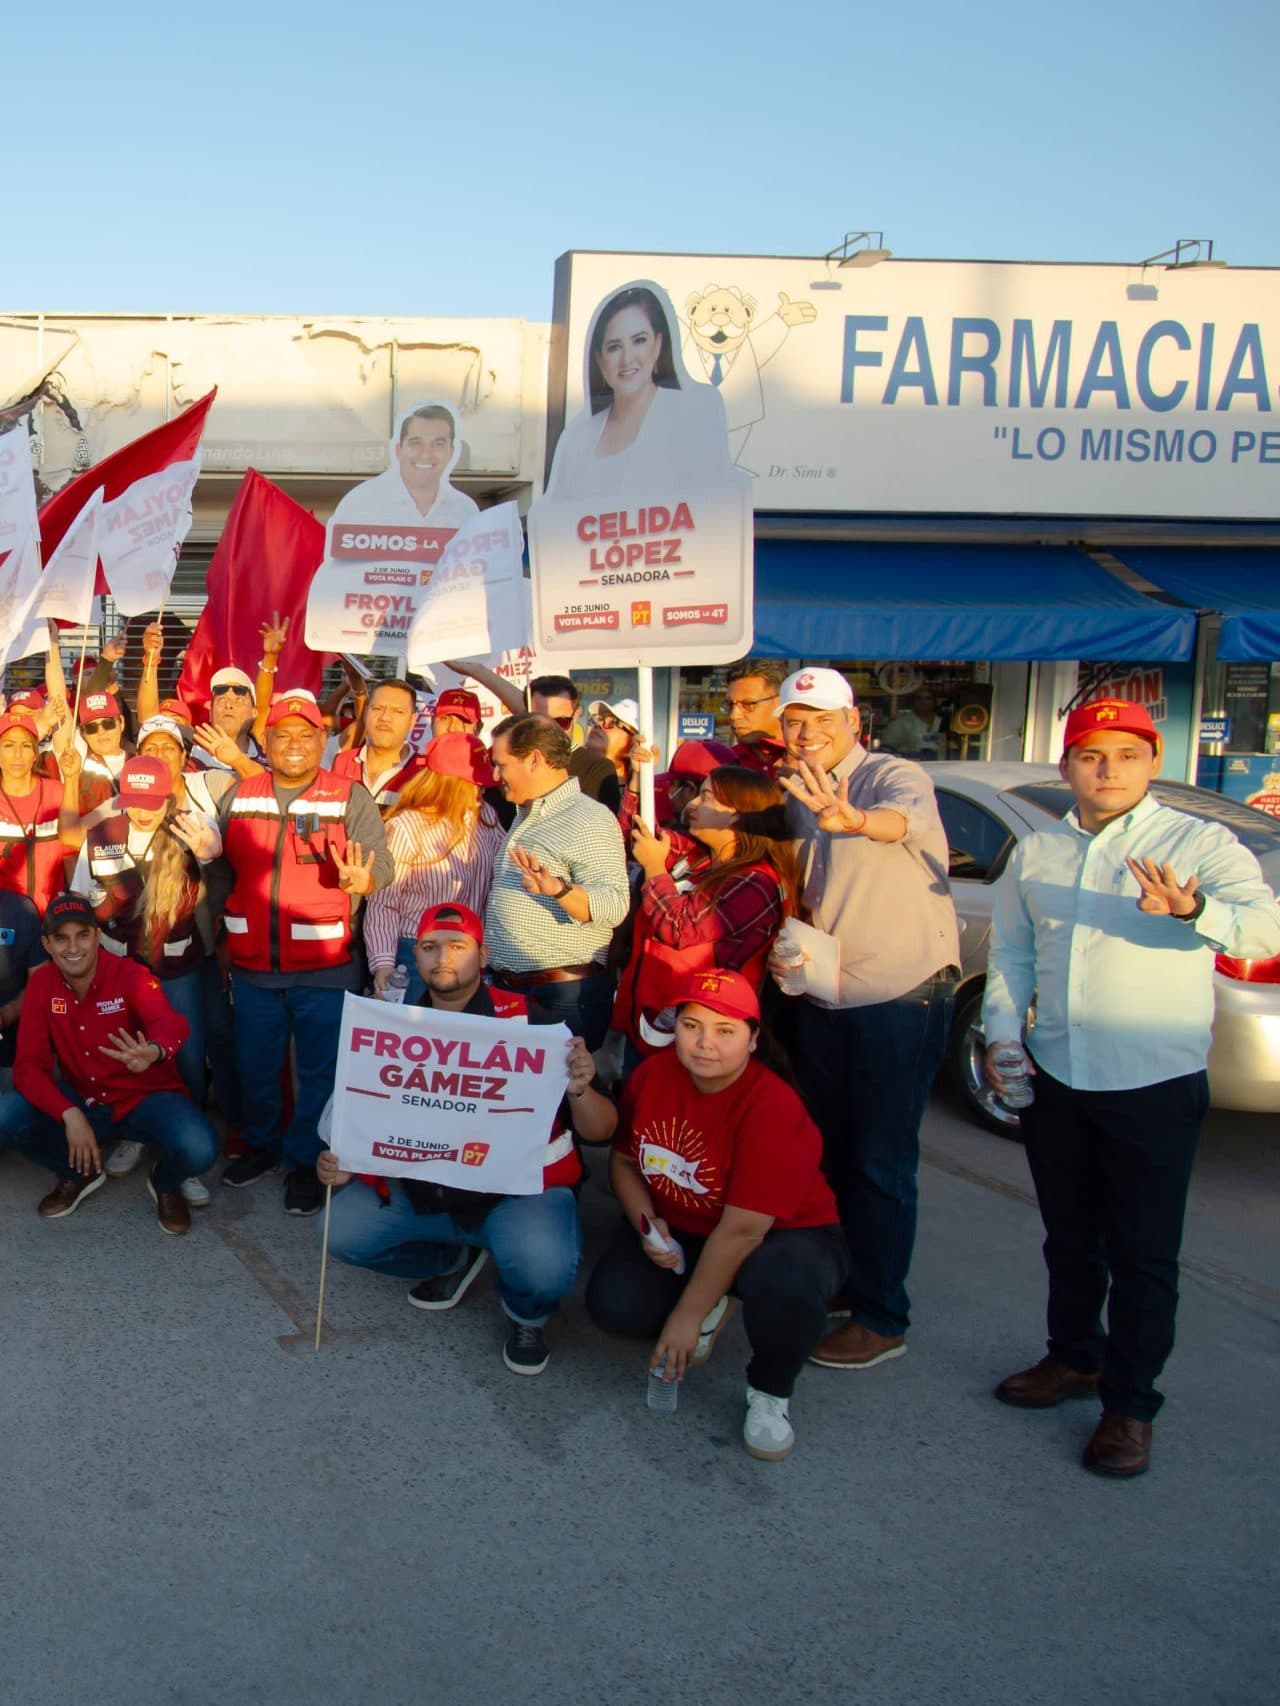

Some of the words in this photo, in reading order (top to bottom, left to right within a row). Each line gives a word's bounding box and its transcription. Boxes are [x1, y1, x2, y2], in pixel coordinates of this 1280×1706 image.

[840, 315, 1280, 413] FARMACIA
[1080, 429, 1217, 463] MISMO
[577, 502, 695, 541] CELIDA
[341, 533, 417, 551] SOMOS
[424, 540, 439, 549] LA
[590, 539, 682, 571] LÓPEZ
[601, 570, 670, 586] SENADORA
[345, 593, 417, 612] FROYL
[584, 603, 610, 611] JUNIO
[559, 618, 581, 627] VOTA
[583, 616, 606, 625] PLAN
[608, 616, 615, 624] C
[632, 610, 649, 623] PT
[666, 612, 700, 621] SOMOS
[711, 609, 724, 619] 4T
[682, 718, 709, 728] DESLICE
[350, 1027, 546, 1075] FROYLÁN
[379, 1063, 508, 1101] GÁMEZ
[401, 1094, 477, 1114] SENADOR
[388, 1135, 395, 1143] 2
[397, 1137, 412, 1147] DE
[414, 1140, 450, 1150] JUNIO
[379, 1146, 408, 1158] VOTA
[411, 1149, 439, 1160] PLAN
[463, 1150, 485, 1165] PT
[646, 1155, 668, 1170] PT
